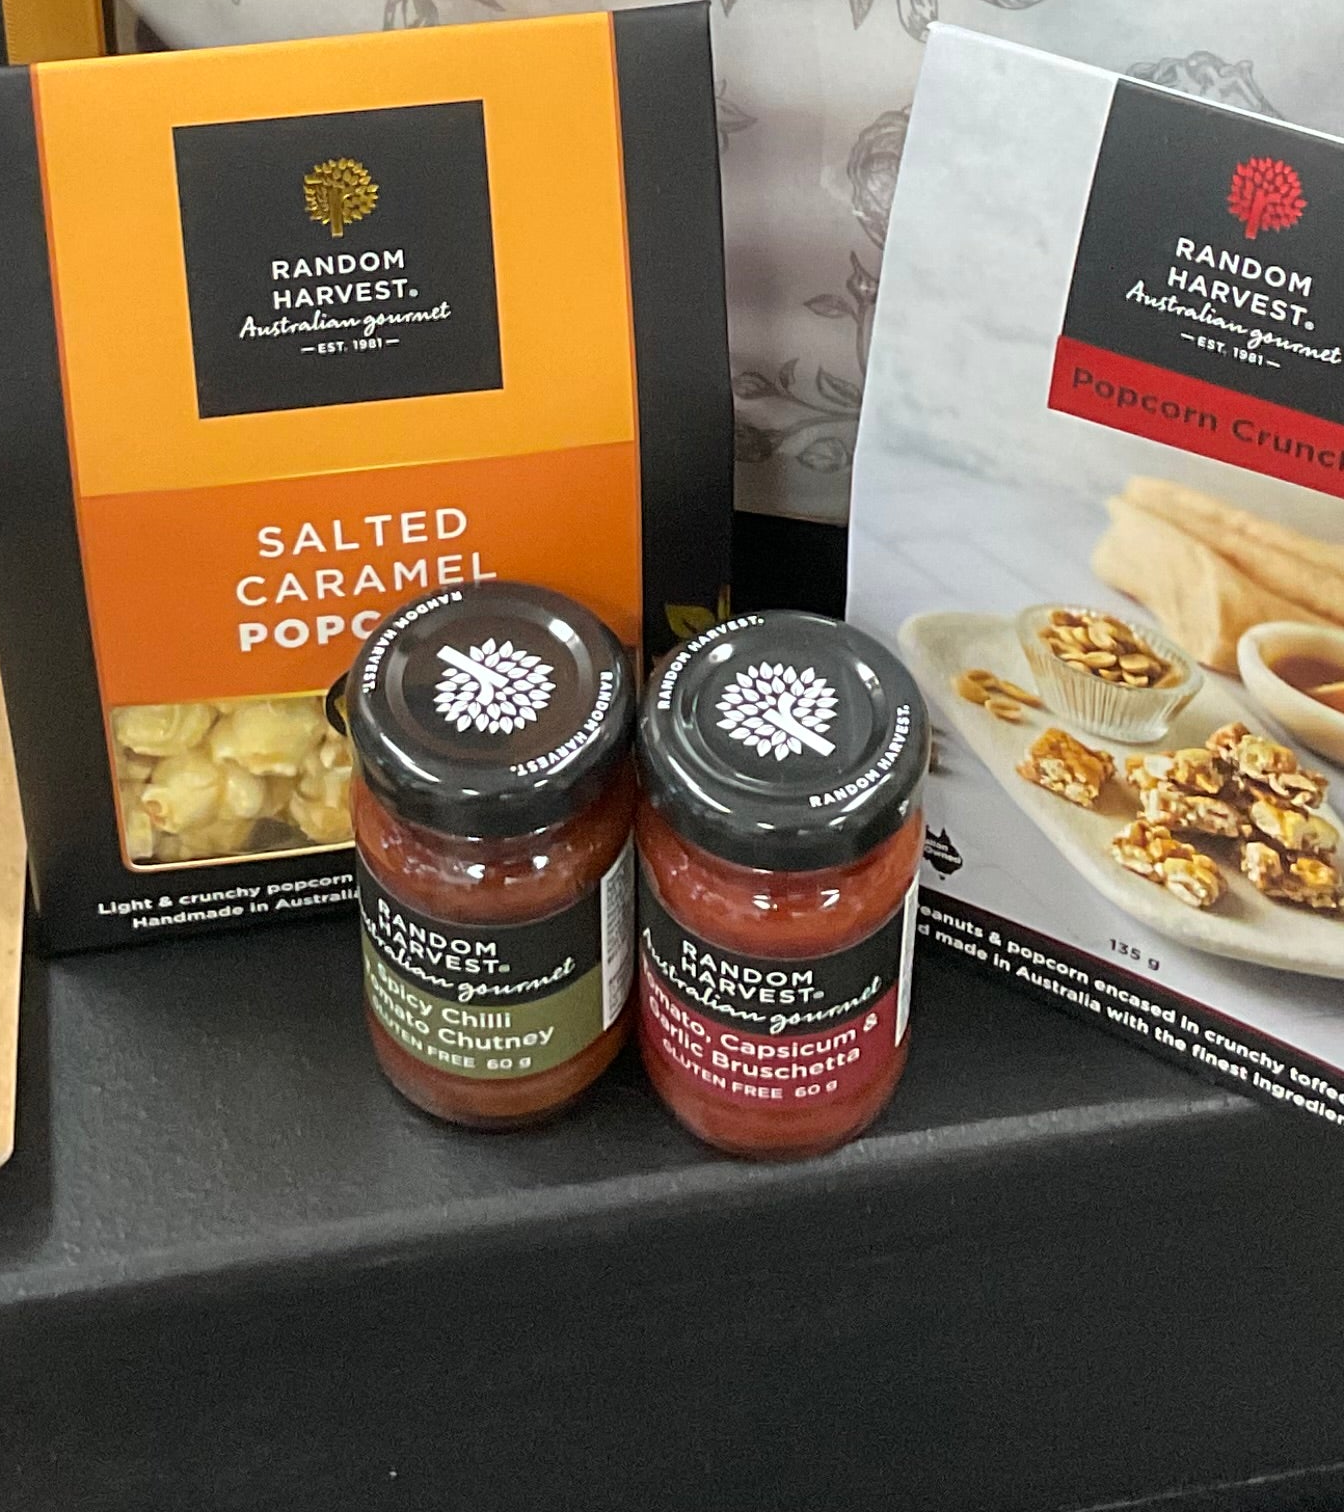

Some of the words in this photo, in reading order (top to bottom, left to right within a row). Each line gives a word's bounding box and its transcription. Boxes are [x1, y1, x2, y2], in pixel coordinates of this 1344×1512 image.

[270, 248, 406, 281] RANDOM
[1175, 235, 1314, 297] RANDOM
[238, 309, 362, 340] Australian
[363, 300, 453, 337] gourmet
[1125, 278, 1249, 337] Australian
[1246, 324, 1344, 366] gourmet
[316, 339, 349, 355] EST.
[352, 336, 384, 352] 1981
[1231, 345, 1265, 367] 1981
[1072, 364, 1219, 433] Popcorn
[258, 507, 468, 559] SALTED
[235, 551, 498, 607] CARAMEL
[392, 589, 464, 631] RANDOM
[583, 670, 615, 737] RANDOM
[656, 650, 692, 711] RANDOM
[808, 767, 881, 809] RANDOM
[96, 896, 154, 916] Light
[158, 895, 174, 909] &
[178, 884, 262, 906] crunchy
[266, 872, 354, 895] popcorn
[131, 905, 245, 930] Handmade
[249, 901, 269, 915] in
[377, 897, 497, 958] RANDOM
[457, 956, 576, 1003] gourmet
[681, 939, 814, 988] RANDOM
[1108, 937, 1142, 962] 135
[1147, 959, 1161, 972] g
[376, 962, 434, 1017] Spicy
[441, 1007, 512, 1030] Chilli
[769, 974, 883, 1036] gourmet
[917, 903, 985, 939] eanuts
[988, 930, 1003, 948] &
[1006, 939, 1090, 986] popcorn
[1093, 978, 1176, 1025] encased
[1179, 1014, 1201, 1036] in
[1203, 1028, 1286, 1076] crunchy
[935, 928, 990, 962] made
[992, 952, 1012, 973] in
[1015, 965, 1103, 1014] Australia
[1105, 1005, 1150, 1036] with
[1153, 1025, 1188, 1052] the
[1191, 1042, 1249, 1082] finest
[426, 1044, 477, 1070] FREE
[486, 1057, 513, 1071] 60
[518, 1055, 532, 1069] g
[437, 1025, 555, 1052] Chutney
[648, 994, 705, 1059] Garlic
[711, 1046, 861, 1081] Bruschetta
[719, 1026, 857, 1061] Capsicum
[862, 1012, 879, 1033] &
[662, 1037, 727, 1090] GLUTEN
[731, 1081, 784, 1100] FREE
[793, 1083, 822, 1099] 60
[824, 1079, 839, 1095] g
